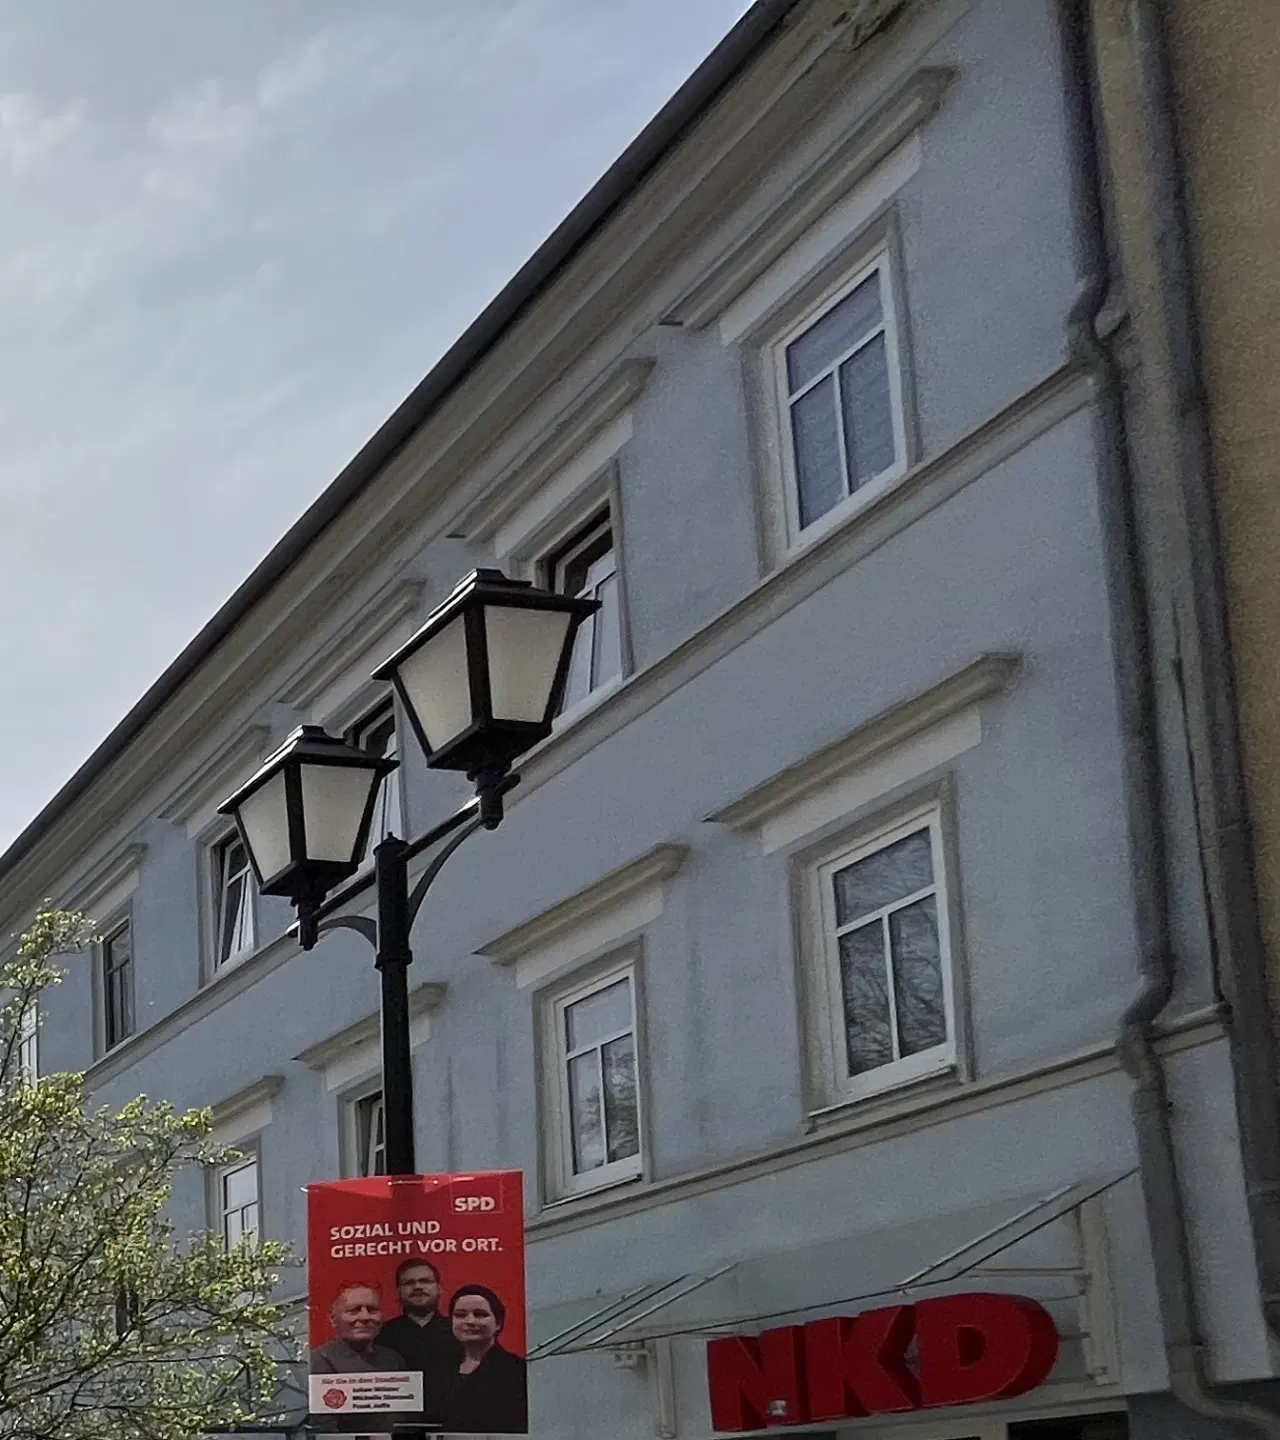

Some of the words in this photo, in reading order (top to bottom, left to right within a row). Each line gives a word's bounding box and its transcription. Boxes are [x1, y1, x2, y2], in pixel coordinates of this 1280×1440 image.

[454, 1196, 495, 1212] SPD
[329, 1222, 393, 1241] SOZIAL
[397, 1220, 441, 1236] UND
[330, 1240, 413, 1259] GERECHT
[417, 1239, 457, 1254] VOR
[461, 1237, 503, 1253] ORT.
[707, 1291, 1060, 1433] NKD
